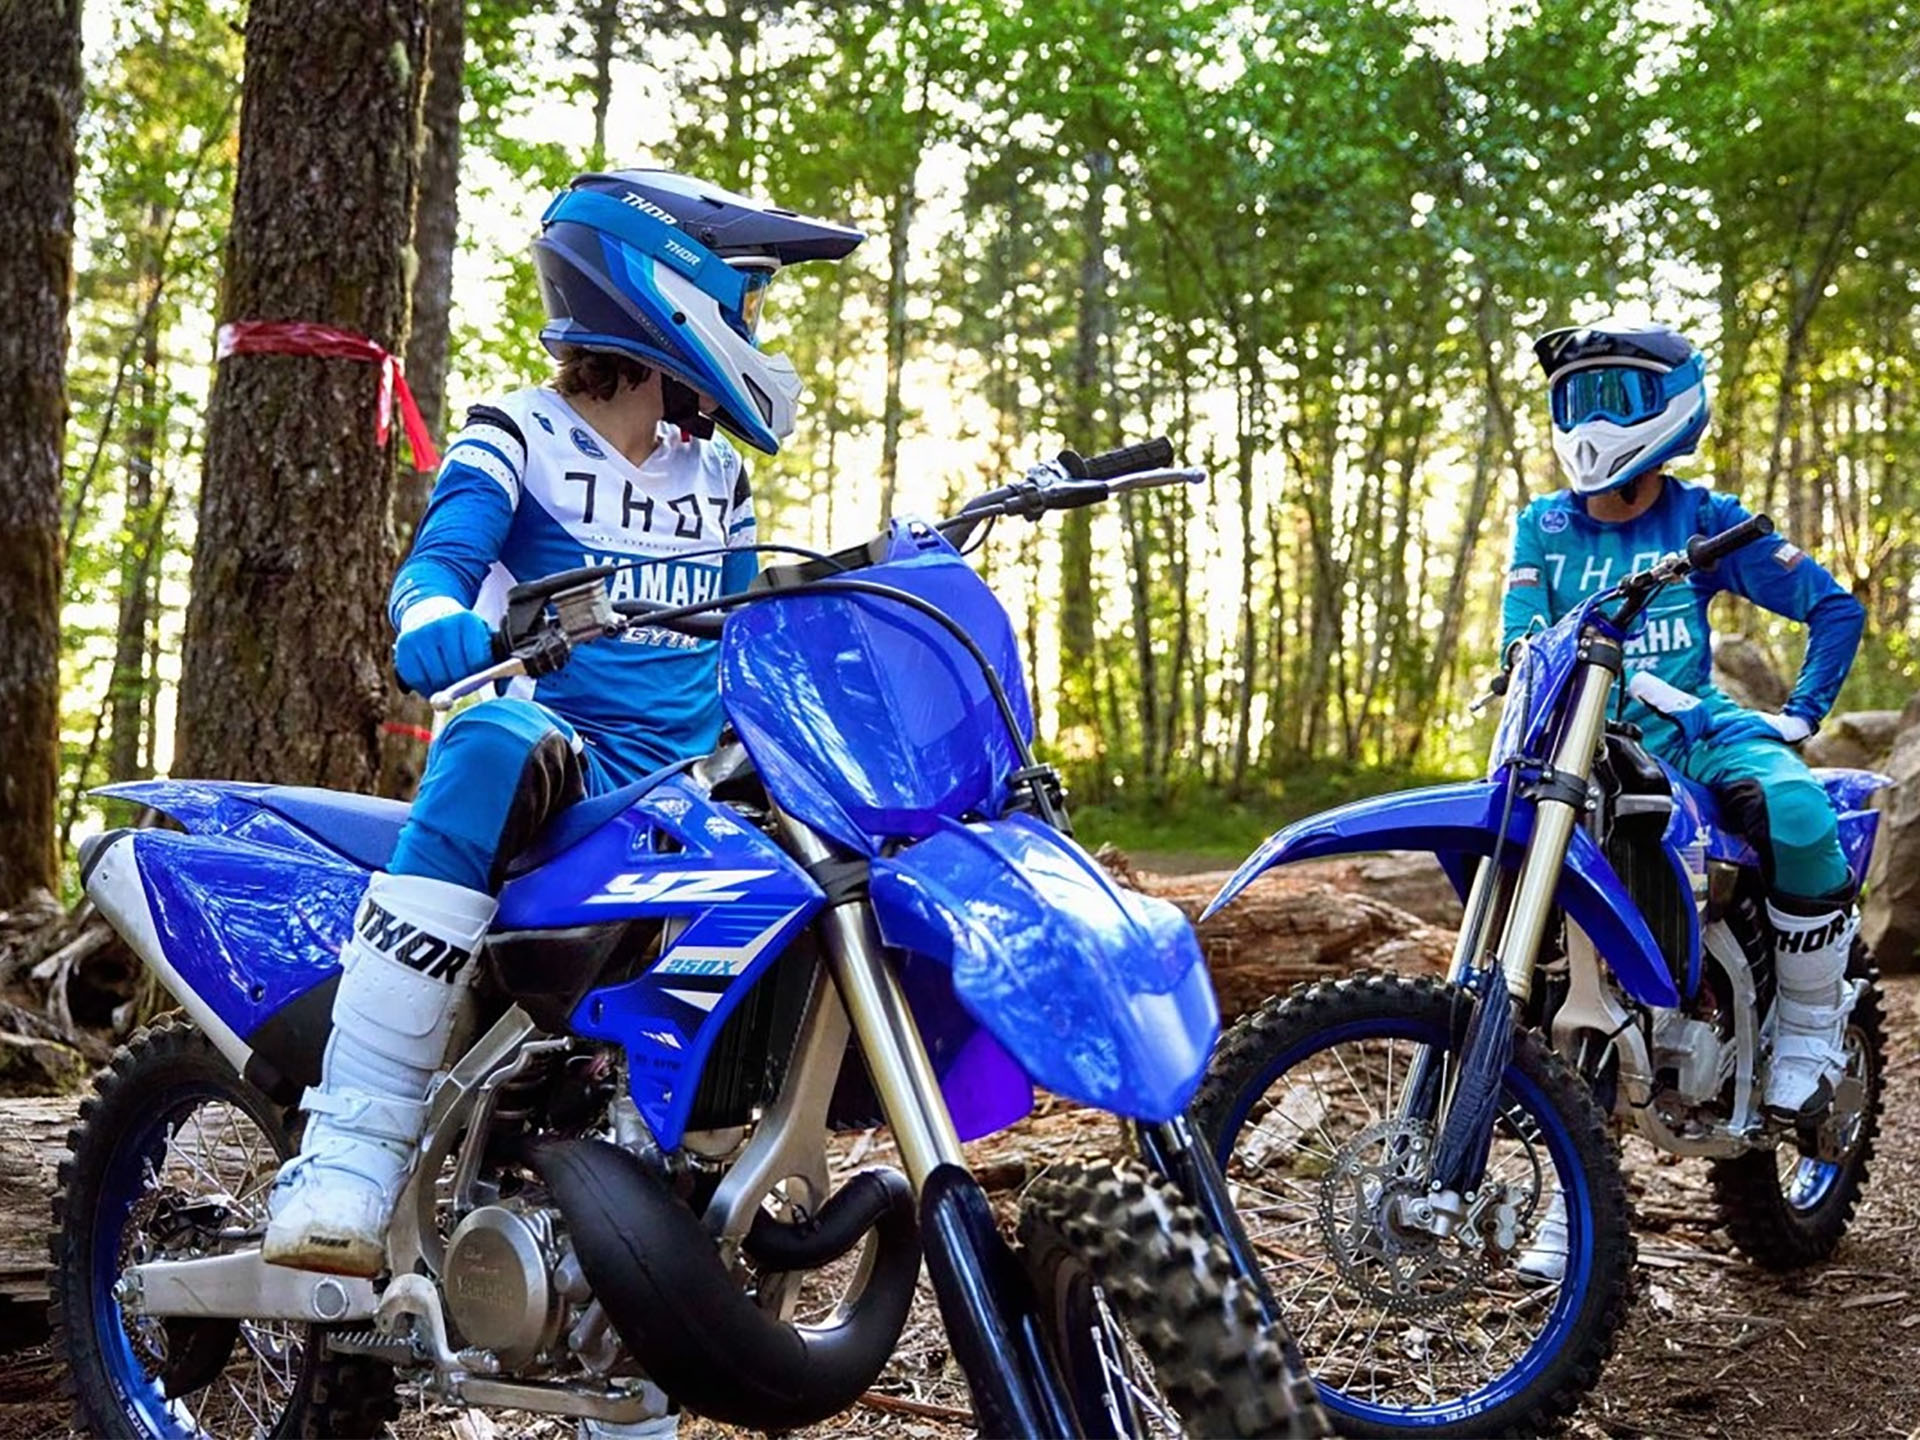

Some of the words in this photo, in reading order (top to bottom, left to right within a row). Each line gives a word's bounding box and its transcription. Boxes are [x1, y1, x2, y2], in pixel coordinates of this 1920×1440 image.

[621, 191, 678, 225] THOR
[664, 239, 701, 266] THOR
[620, 626, 700, 650] GYTR
[579, 869, 779, 904] YZ
[359, 897, 471, 985] THOR
[664, 958, 740, 976] 250X
